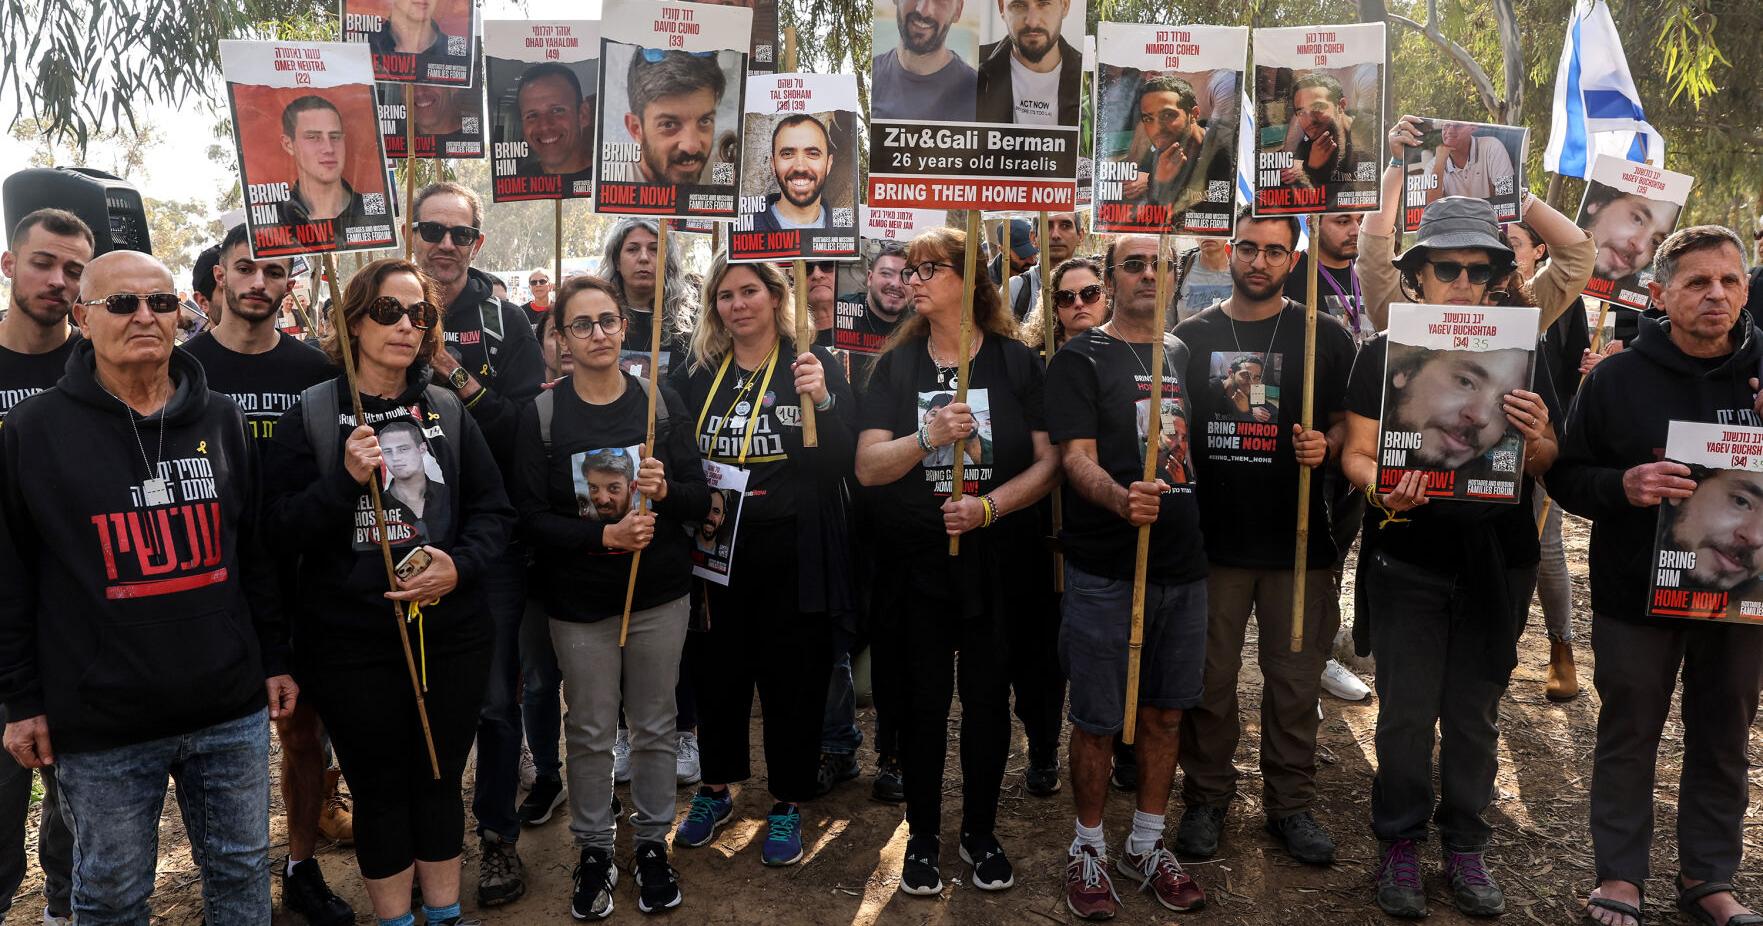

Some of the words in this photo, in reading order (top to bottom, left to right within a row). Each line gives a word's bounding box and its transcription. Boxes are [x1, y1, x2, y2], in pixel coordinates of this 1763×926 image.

[346, 13, 382, 32] BRING
[682, 9, 694, 21] דוד
[654, 21, 676, 34] DAVID
[678, 23, 699, 35] CUNIO
[526, 38, 544, 47] OHAD
[545, 38, 578, 47] YAHALOMI
[669, 35, 684, 48] (33)
[1156, 31, 1168, 42] כהן
[1171, 32, 1190, 42] נמרוד
[1306, 33, 1316, 43] כהן
[1319, 32, 1336, 42] נמרוד
[546, 49, 560, 60] (49)
[1146, 44, 1174, 55] NIMROD
[1176, 44, 1200, 55] COHEN
[1297, 44, 1322, 55] NIMROD
[1324, 44, 1344, 53] COHEN
[274, 60, 296, 71] OMER
[298, 61, 326, 72] NEUTRA
[383, 54, 416, 73] NOW!
[1166, 57, 1179, 68] (19)
[296, 73, 310, 84] (22)
[770, 91, 781, 99] TAL
[784, 90, 811, 99] SHOHAM
[792, 100, 805, 111] (39)
[1033, 101, 1049, 109] NOW
[384, 136, 406, 150] OME
[415, 134, 436, 151] OW!
[884, 128, 978, 150] Ziv&Gali
[988, 131, 1066, 152] Berman
[495, 142, 528, 159] BRING
[602, 144, 641, 163] BRING
[496, 160, 517, 176] HIM
[892, 153, 911, 167] 26
[918, 155, 962, 170] years
[969, 155, 994, 169] old
[1000, 156, 1057, 171] Israelis
[1260, 151, 1293, 169] BRING
[602, 163, 626, 182] HIM
[1100, 161, 1137, 181] BRING
[1260, 170, 1280, 187] HIM
[496, 178, 526, 194] HOME
[530, 175, 562, 193] NOW!
[1407, 174, 1438, 191] BRING
[248, 182, 290, 204] BRING
[600, 185, 636, 205] HOME
[640, 185, 676, 206] NOW!
[874, 184, 926, 201] BRING
[932, 184, 977, 202] THEM
[982, 186, 1027, 202] HOME
[1032, 187, 1072, 204] NOW!
[1099, 182, 1123, 200] HIM
[1260, 189, 1291, 206] HOME
[1294, 184, 1326, 205] NOW!
[1407, 190, 1426, 206] HIM
[689, 200, 712, 209] FAMILIES
[713, 201, 733, 210] FORUM
[740, 196, 766, 213] RING
[1337, 197, 1359, 205] FAMILIES
[253, 204, 278, 225] HIM
[1097, 204, 1135, 222] HOME
[1137, 203, 1172, 224] NOW!
[296, 220, 335, 243] NOW!
[869, 219, 887, 228] ALMOG
[889, 220, 902, 229] MEIR
[903, 221, 913, 230] JAN
[1185, 219, 1209, 228] FAMILIES
[1209, 219, 1229, 229] FORUM
[256, 226, 295, 248] HOME
[347, 232, 371, 243] FAMILIES
[372, 231, 392, 241] FORUM
[733, 234, 765, 250] HOME
[768, 231, 800, 250] NOW!
[1587, 277, 1615, 294] NOW!
[837, 301, 863, 317] BRING
[837, 316, 853, 330] HIM
[1473, 314, 1484, 324] יגב
[444, 331, 459, 342] OME
[837, 330, 861, 344] HOME
[1428, 324, 1452, 335] YAGEV
[1453, 325, 1496, 336] BUCHSHTAB
[1453, 336, 1469, 348] (34)
[1473, 338, 1488, 350] 35
[1208, 422, 1236, 435] BRING
[1237, 422, 1278, 437] NIMROD
[1208, 436, 1240, 449] HOME
[1242, 436, 1277, 452] NOW!
[1384, 431, 1422, 450] BRING
[1706, 442, 1730, 453] YAGEV
[1383, 449, 1407, 467] HIM
[925, 469, 944, 481] BRING
[964, 468, 979, 481] AND
[981, 468, 992, 480] ZIV
[181, 478, 218, 501] אותם
[1468, 486, 1492, 494] FAMILIES
[1494, 487, 1514, 495] FORUM
[355, 508, 402, 526] HOSAGE
[357, 528, 370, 543] BY
[372, 525, 410, 542] HMAS
[1658, 550, 1696, 570] BRING
[1656, 569, 1680, 587] HIM
[1654, 589, 1690, 608] HOME
[1692, 591, 1728, 612] NOW!
